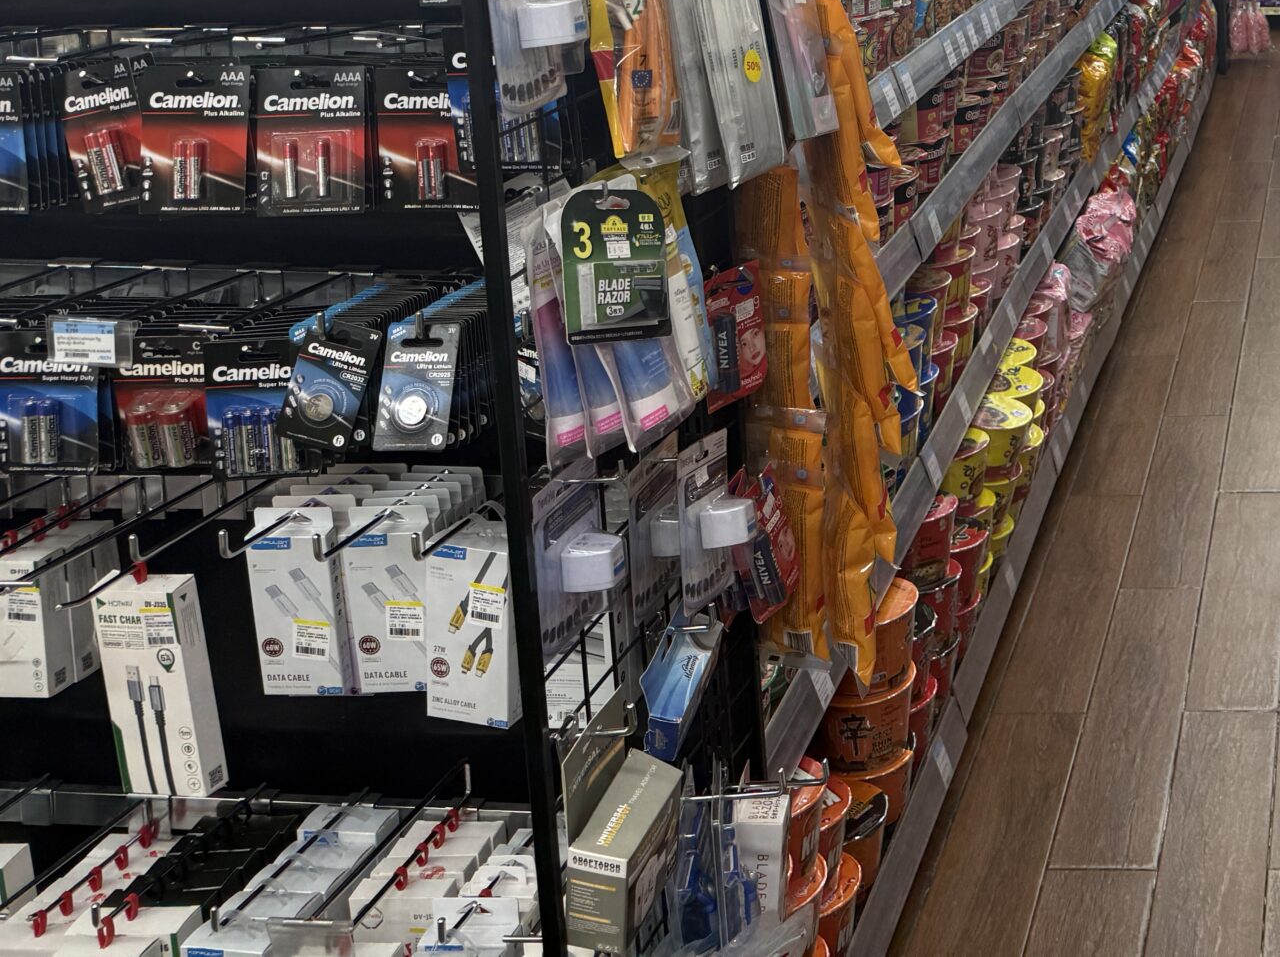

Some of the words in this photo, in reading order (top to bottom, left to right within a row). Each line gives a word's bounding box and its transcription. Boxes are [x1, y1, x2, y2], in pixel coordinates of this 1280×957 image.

[746, 61, 761, 71] 50%
[220, 71, 245, 81] AAA
[334, 72, 361, 82] AAAA
[64, 86, 130, 112] Camelion
[150, 93, 238, 109] Camelion
[264, 95, 353, 111] Camelion
[110, 103, 120, 111] Plus
[573, 222, 593, 258] 3
[598, 278, 631, 292] BLADE
[598, 292, 631, 304] RAZOR
[308, 343, 365, 366] Camelion
[391, 351, 448, 362] Camelion
[720, 331, 728, 369] NIVEA
[213, 363, 291, 382] Camelio
[332, 361, 348, 369] Ultra
[349, 366, 367, 374] Lithium
[342, 372, 364, 382] CR2032
[754, 551, 772, 586] NIVEA
[99, 615, 117, 624] FAST
[432, 696, 444, 704] ZINC
[445, 698, 459, 707] ALLOY
[460, 701, 476, 709] CABLE
[841, 715, 875, 756] 辛
